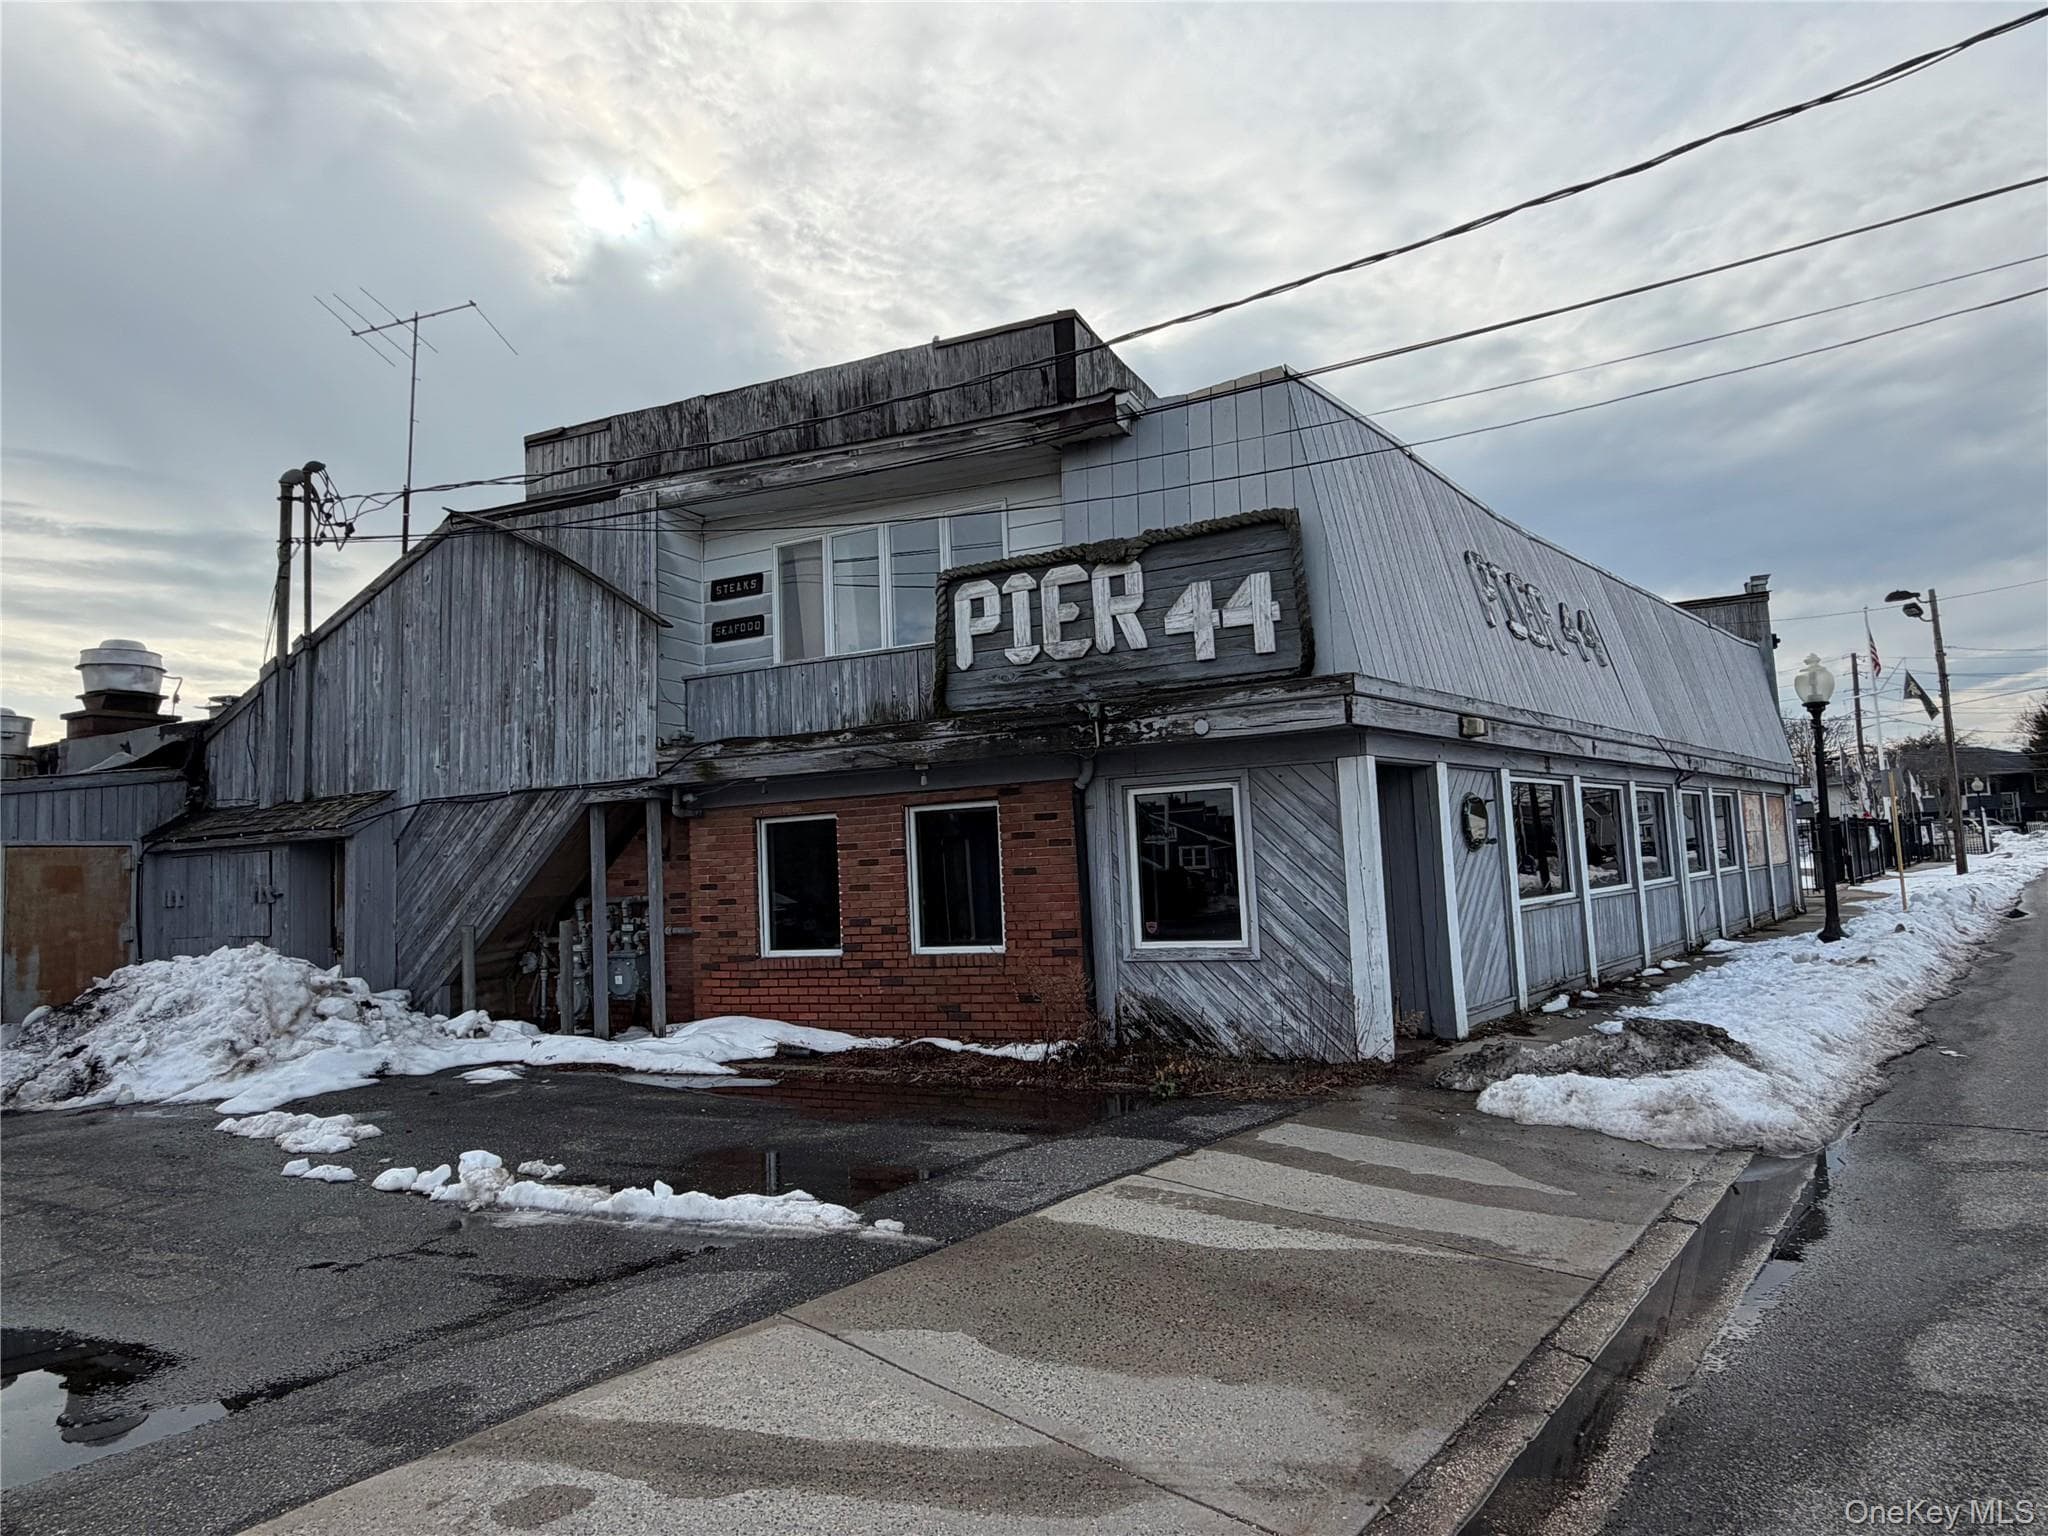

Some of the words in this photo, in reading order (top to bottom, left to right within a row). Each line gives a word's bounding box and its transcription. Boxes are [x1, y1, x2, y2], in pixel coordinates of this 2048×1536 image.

[716, 579, 757, 595] STEAKS
[954, 560, 1148, 671] PIER
[1164, 571, 1281, 661] 44
[1464, 550, 1568, 656] PIER
[1558, 602, 1608, 667] 44
[715, 620, 761, 637] SEAFOOD
